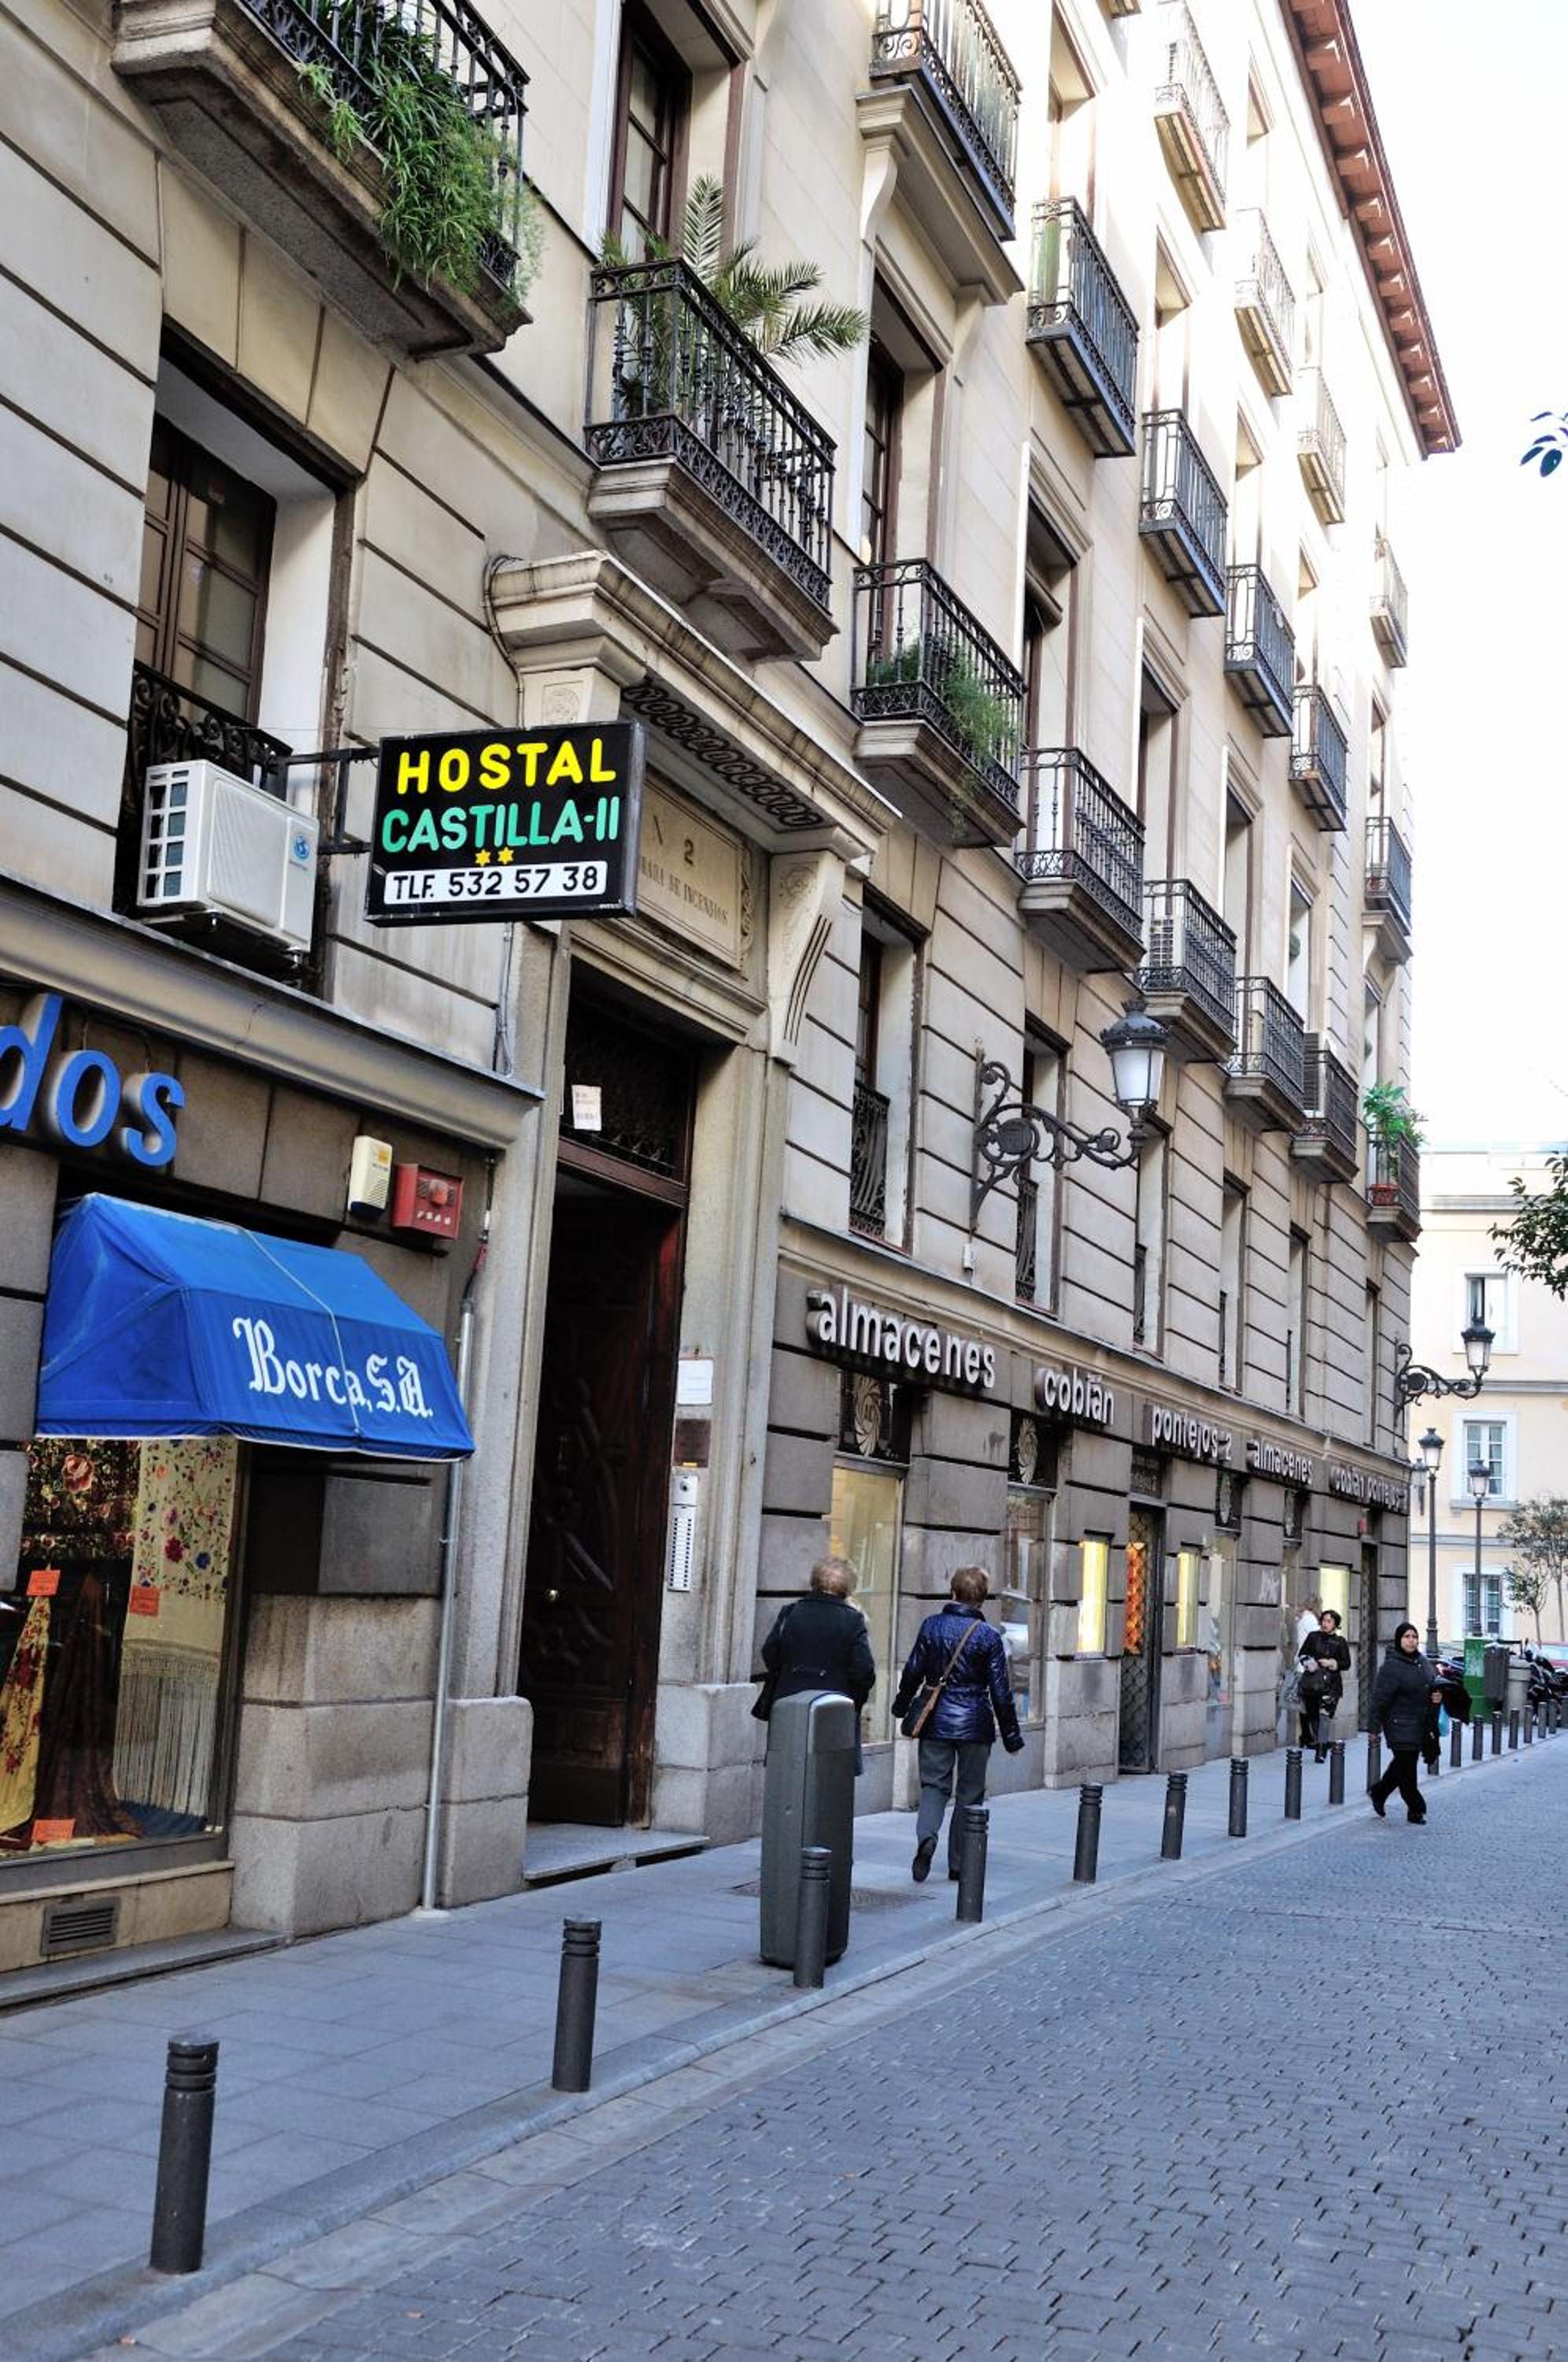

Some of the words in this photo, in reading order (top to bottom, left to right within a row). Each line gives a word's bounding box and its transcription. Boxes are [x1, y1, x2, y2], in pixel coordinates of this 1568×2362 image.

[397, 738, 616, 794] HOSTAL
[382, 796, 620, 853] CASTILLA-II
[683, 838, 694, 867] 2
[393, 875, 435, 900] TLF.
[449, 872, 502, 897] 532
[514, 868, 551, 894] 57
[563, 865, 598, 892] 38
[815, 1285, 996, 1388] almacenes
[1252, 1436, 1313, 1486] almacenes
